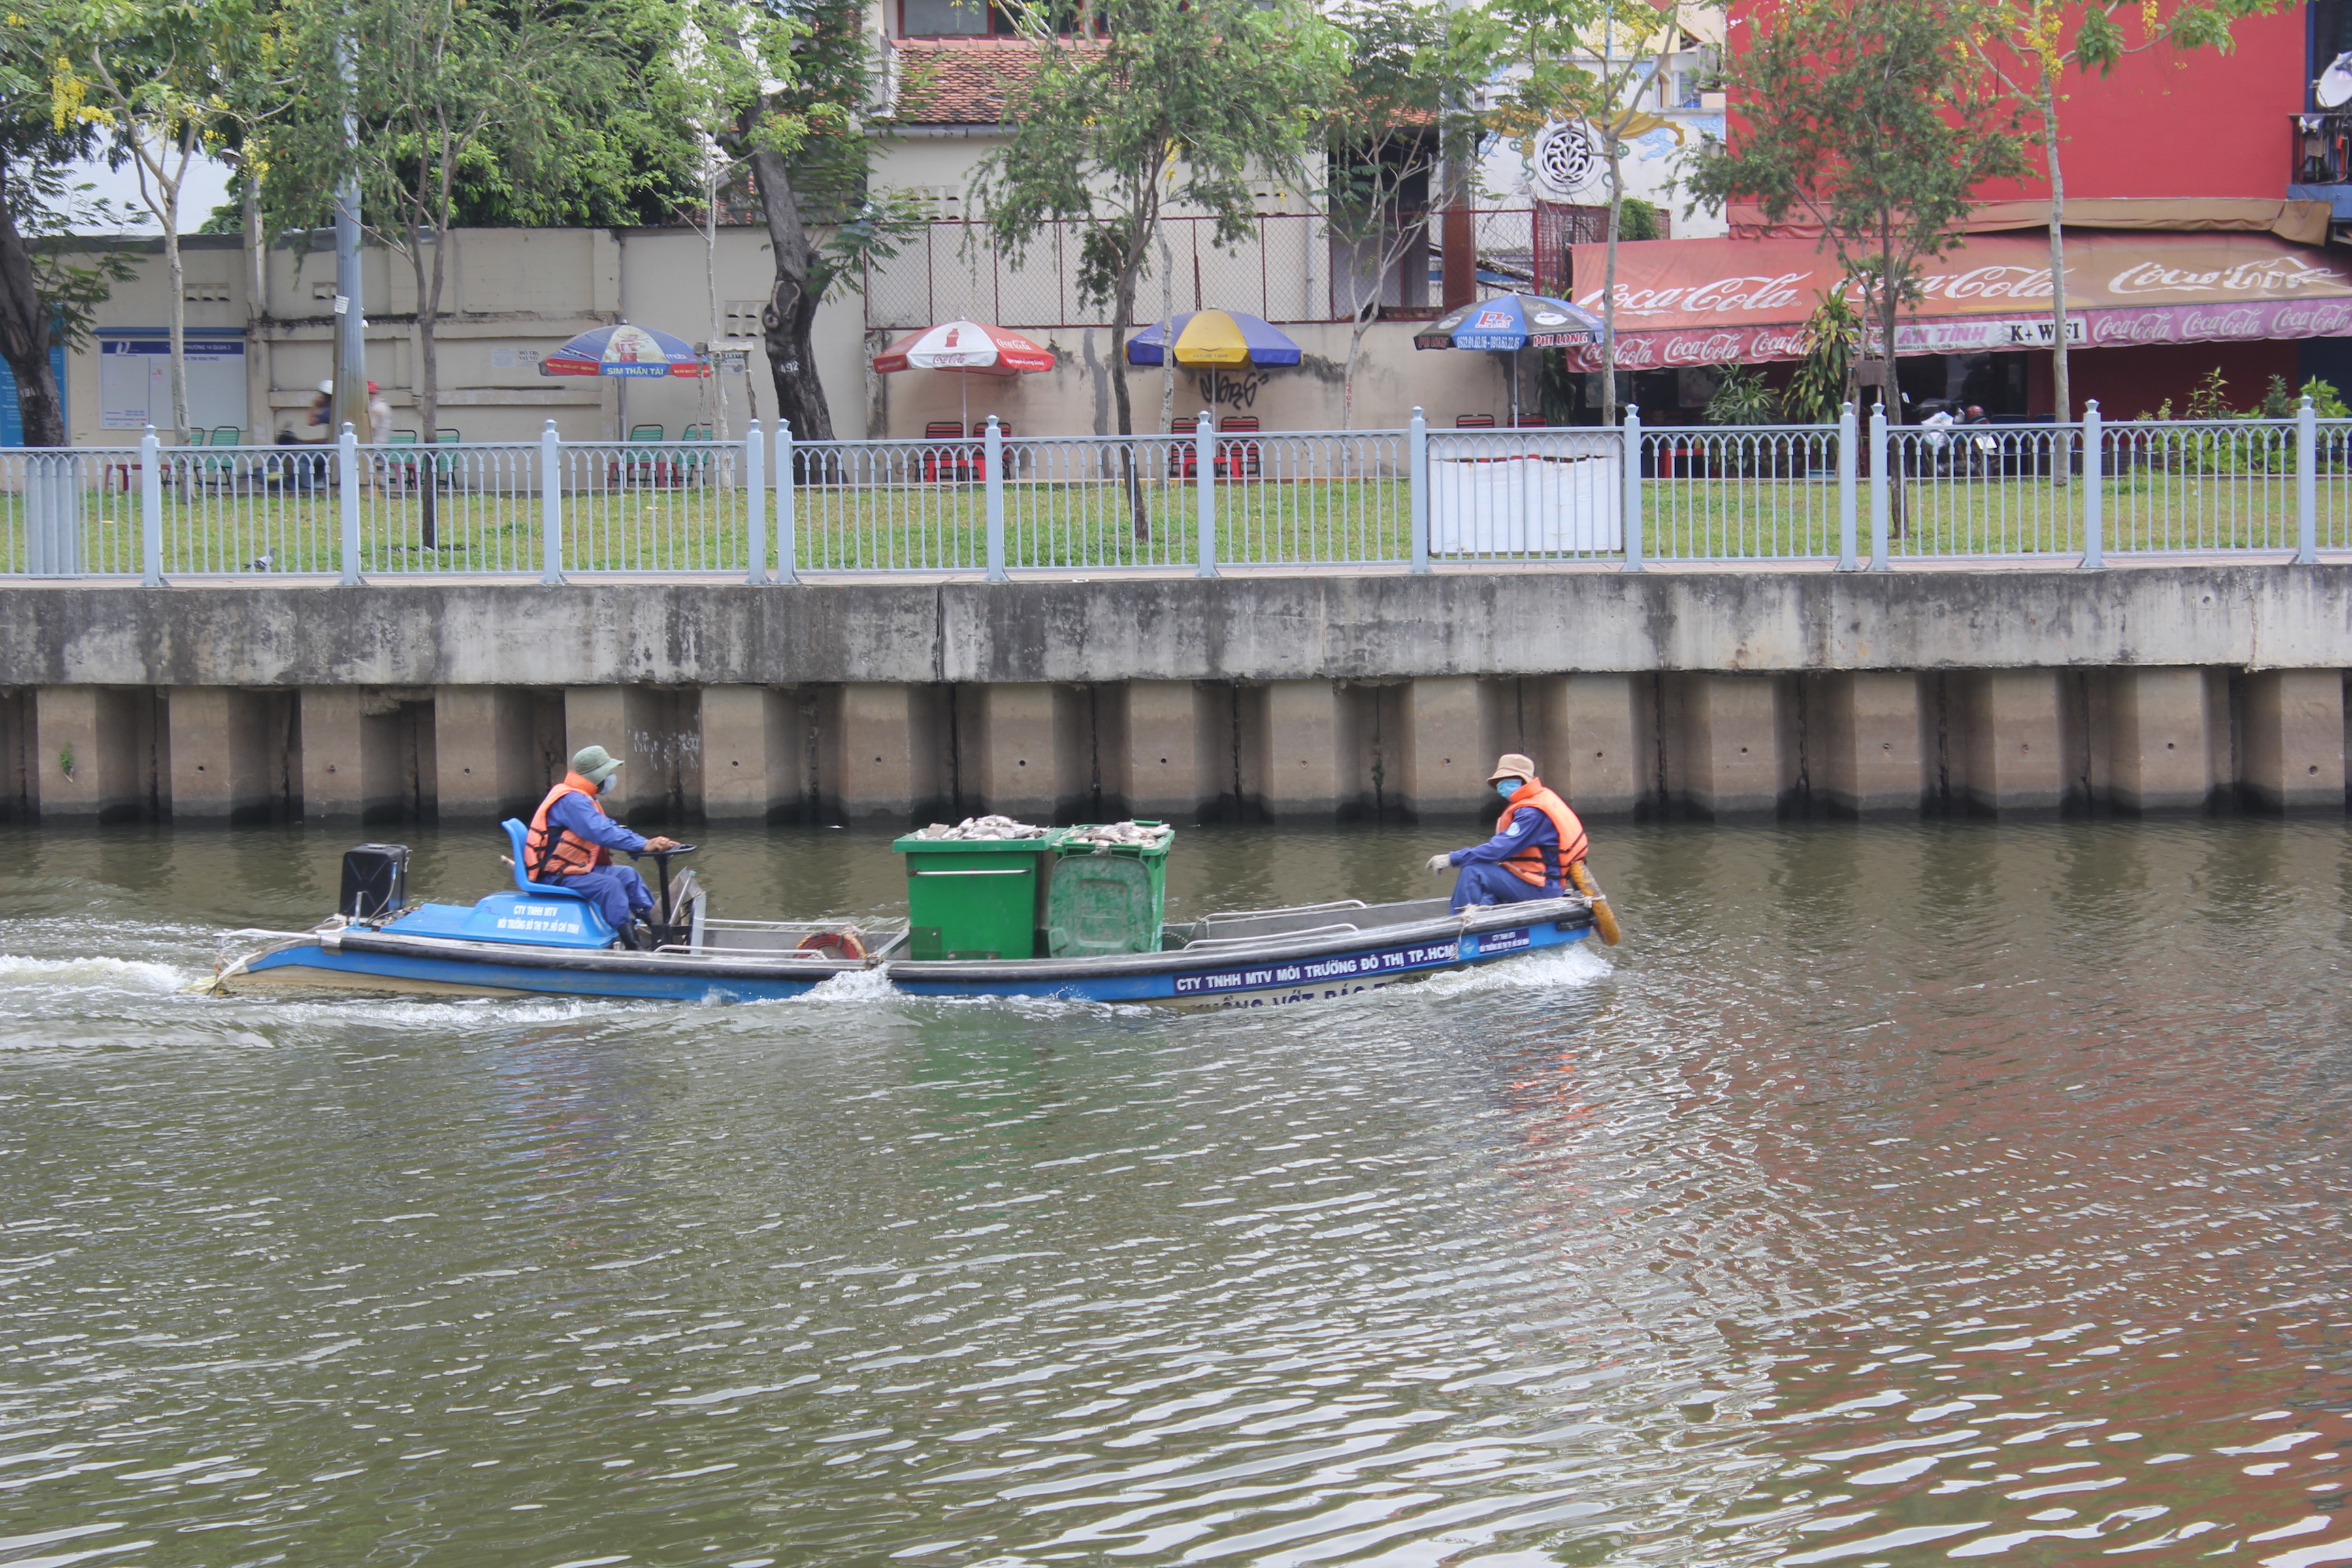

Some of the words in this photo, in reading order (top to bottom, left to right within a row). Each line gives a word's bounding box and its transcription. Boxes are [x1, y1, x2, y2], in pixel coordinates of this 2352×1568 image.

[2011, 325, 2033, 342] K+
[2038, 323, 2080, 339] WFI
[2093, 312, 2174, 342] Coca-Cola
[2182, 309, 2264, 337] Coca-Cola
[1533, 335, 1554, 347] PHI
[1556, 331, 1588, 346] LONG
[1898, 326, 1929, 344] ÂN
[1663, 333, 1743, 362] Coca-Cola
[650, 367, 664, 376] TÀI
[1176, 977, 1202, 991] CTY
[1205, 974, 1242, 988] TNHH
[1245, 970, 1273, 985] MTV
[1277, 965, 1301, 981] MÔI
[1304, 958, 1357, 978] TRƯỜNG
[1360, 954, 1379, 971] ĐÔ
[1382, 952, 1405, 968] THỊ
[1407, 943, 1458, 964] TP.HCM
